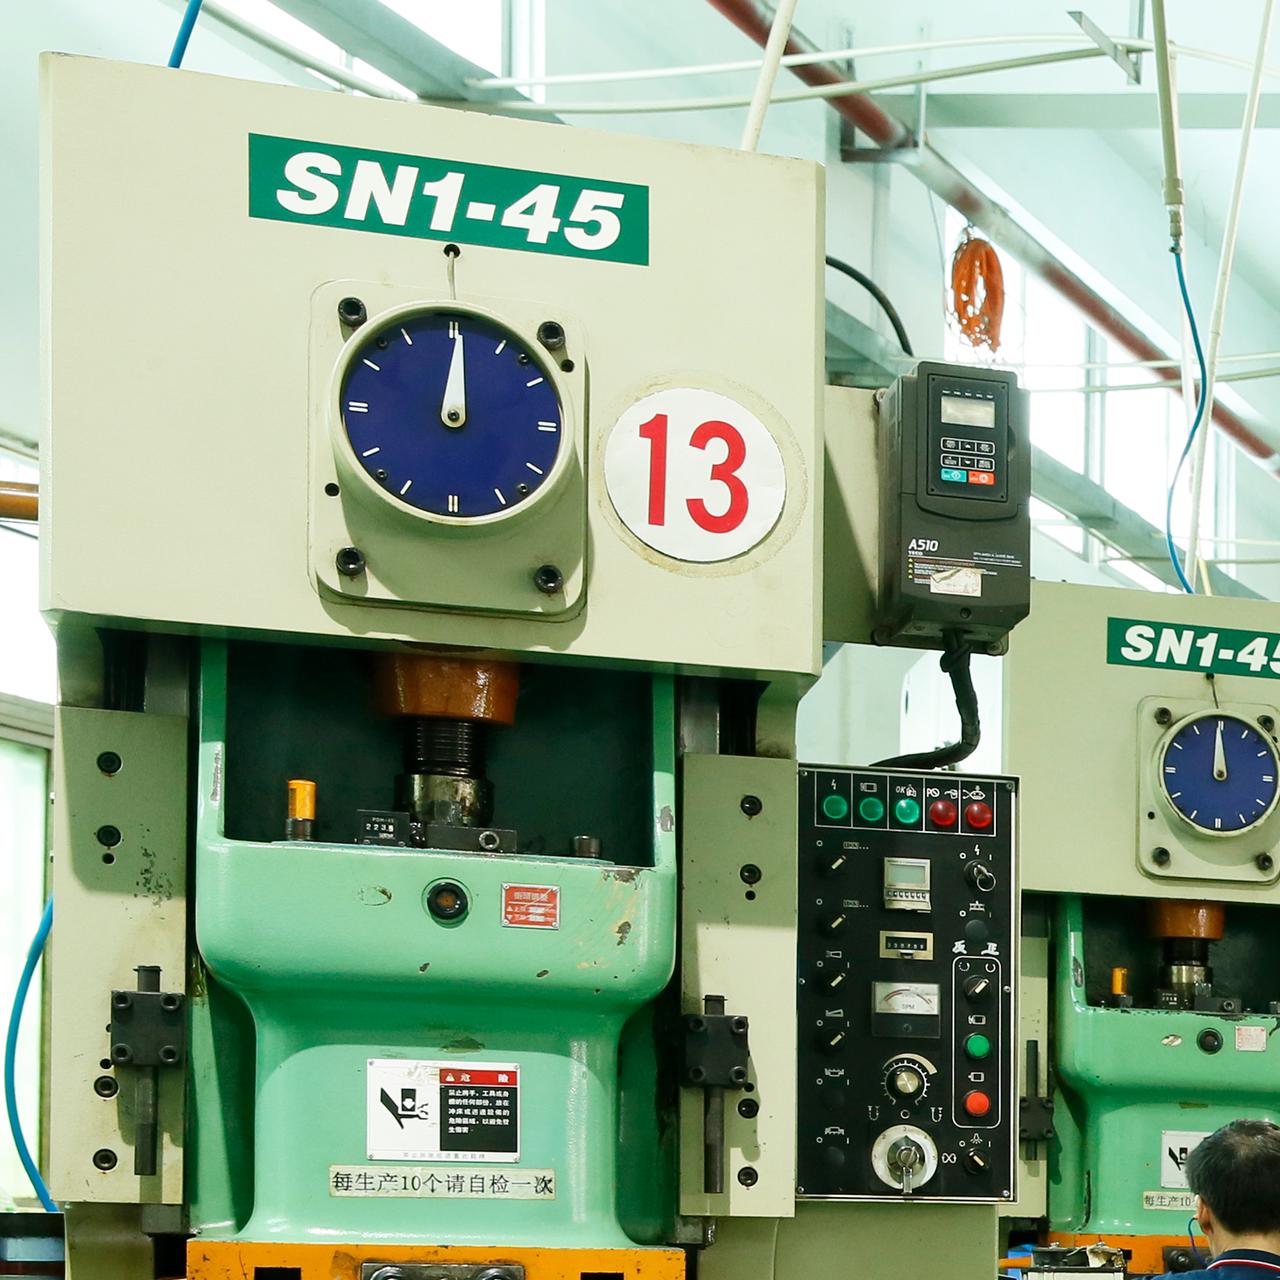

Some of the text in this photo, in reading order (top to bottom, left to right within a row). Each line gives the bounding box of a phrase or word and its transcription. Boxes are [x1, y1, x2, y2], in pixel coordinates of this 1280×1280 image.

[276, 151, 625, 251] SN1-45
[639, 413, 749, 534] 13
[908, 538, 939, 552] A510
[332, 1171, 553, 1195] 每生产10个请自检一次
[1144, 1195, 1195, 1207] 每生产10
